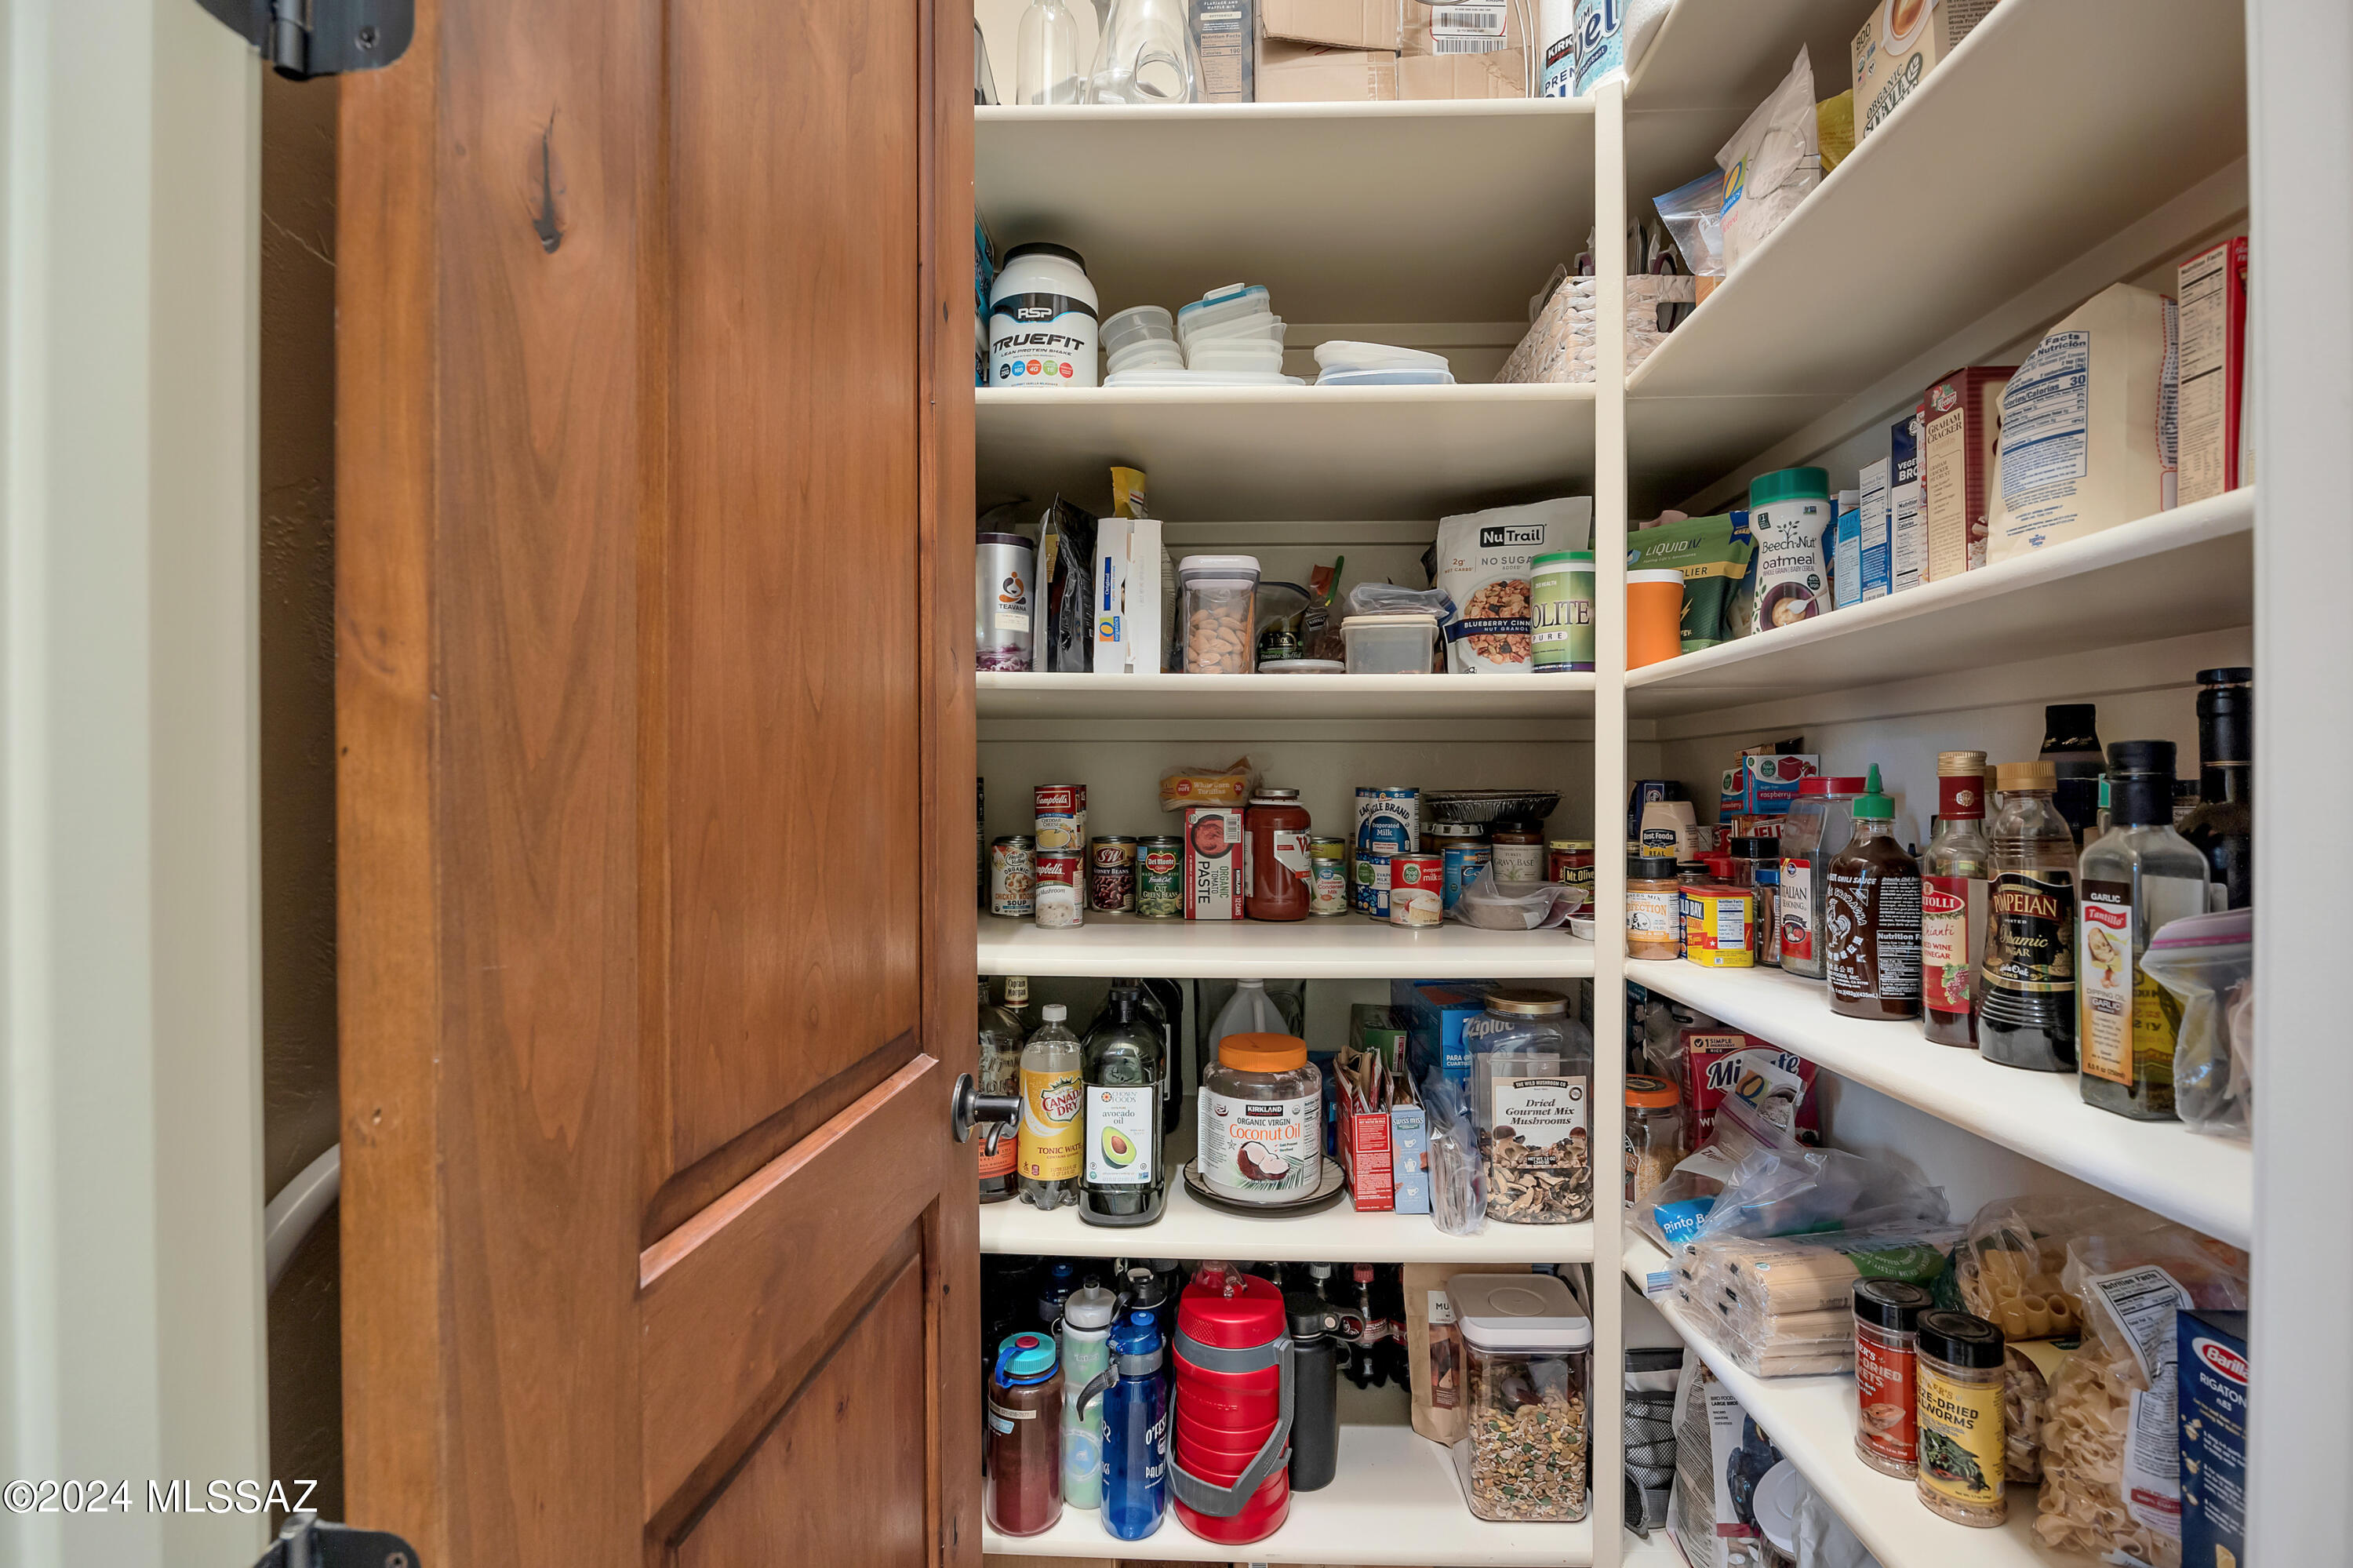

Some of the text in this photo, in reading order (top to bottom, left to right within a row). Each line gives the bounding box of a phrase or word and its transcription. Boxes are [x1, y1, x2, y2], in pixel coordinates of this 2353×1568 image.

[1856, 23, 1871, 51] 800
[1866, 63, 1903, 120] ORGANIC
[2206, 250, 2224, 262] Facts
[1017, 307, 1053, 319] RSP
[992, 333, 1085, 355] TRUEFIT
[2045, 333, 2080, 345] Facts
[2037, 340, 2086, 356] Nutrición
[2070, 374, 2086, 387] 30
[1928, 413, 1962, 435] GRAHAM
[1927, 421, 1962, 445] CRACKER
[1646, 540, 1689, 557] LIQUID
[1481, 557, 1497, 566] NO
[1762, 551, 1815, 569] oatmeal
[998, 603, 1027, 612] TEAVANA
[1384, 802, 1410, 820] BRAND
[1493, 857, 1534, 868] GRAVY BASE
[1198, 860, 1210, 904] PASTE
[1219, 865, 1229, 898] ORGANIC
[1423, 873, 1438, 882] milk
[1566, 870, 1595, 881] Mt. Olive
[1837, 875, 1853, 884] CHILI
[1781, 882, 1807, 900] ITALIAN
[1781, 899, 1804, 911] SEASONING
[2090, 893, 2121, 904] GARLIC
[1689, 900, 1702, 919] BAY
[1834, 886, 1867, 927] SRIRACHA
[2088, 908, 2122, 926] Tantillo
[1878, 932, 1915, 940] Nutrition
[1933, 943, 1952, 951] WINE
[1923, 949, 1951, 960] VINEGAR
[1007, 978, 1027, 988] Captain
[1007, 986, 1027, 998] Morgan
[2086, 987, 2126, 1002] DIPPING OIL
[2092, 998, 2121, 1011] GARLIC
[1467, 1018, 1515, 1040] Ziploc
[1704, 1039, 1709, 1048] 1
[1707, 1053, 1799, 1090] Mite
[1056, 1101, 1078, 1117] DRY
[1526, 1098, 1555, 1108] Dried
[1505, 1107, 1575, 1116] Gourmet Mix
[1113, 1116, 1124, 1125] oil
[1237, 1116, 1291, 1126] ORGANIC VIRGIN
[1509, 1116, 1572, 1125] Mushrooms
[1229, 1122, 1300, 1141] Coconut Oil
[1037, 1146, 1064, 1155] TONIC
[1664, 1217, 1694, 1235] Pinto
[2100, 1271, 2158, 1292] Nutrition Facts
[1145, 1462, 1164, 1479] PALM
